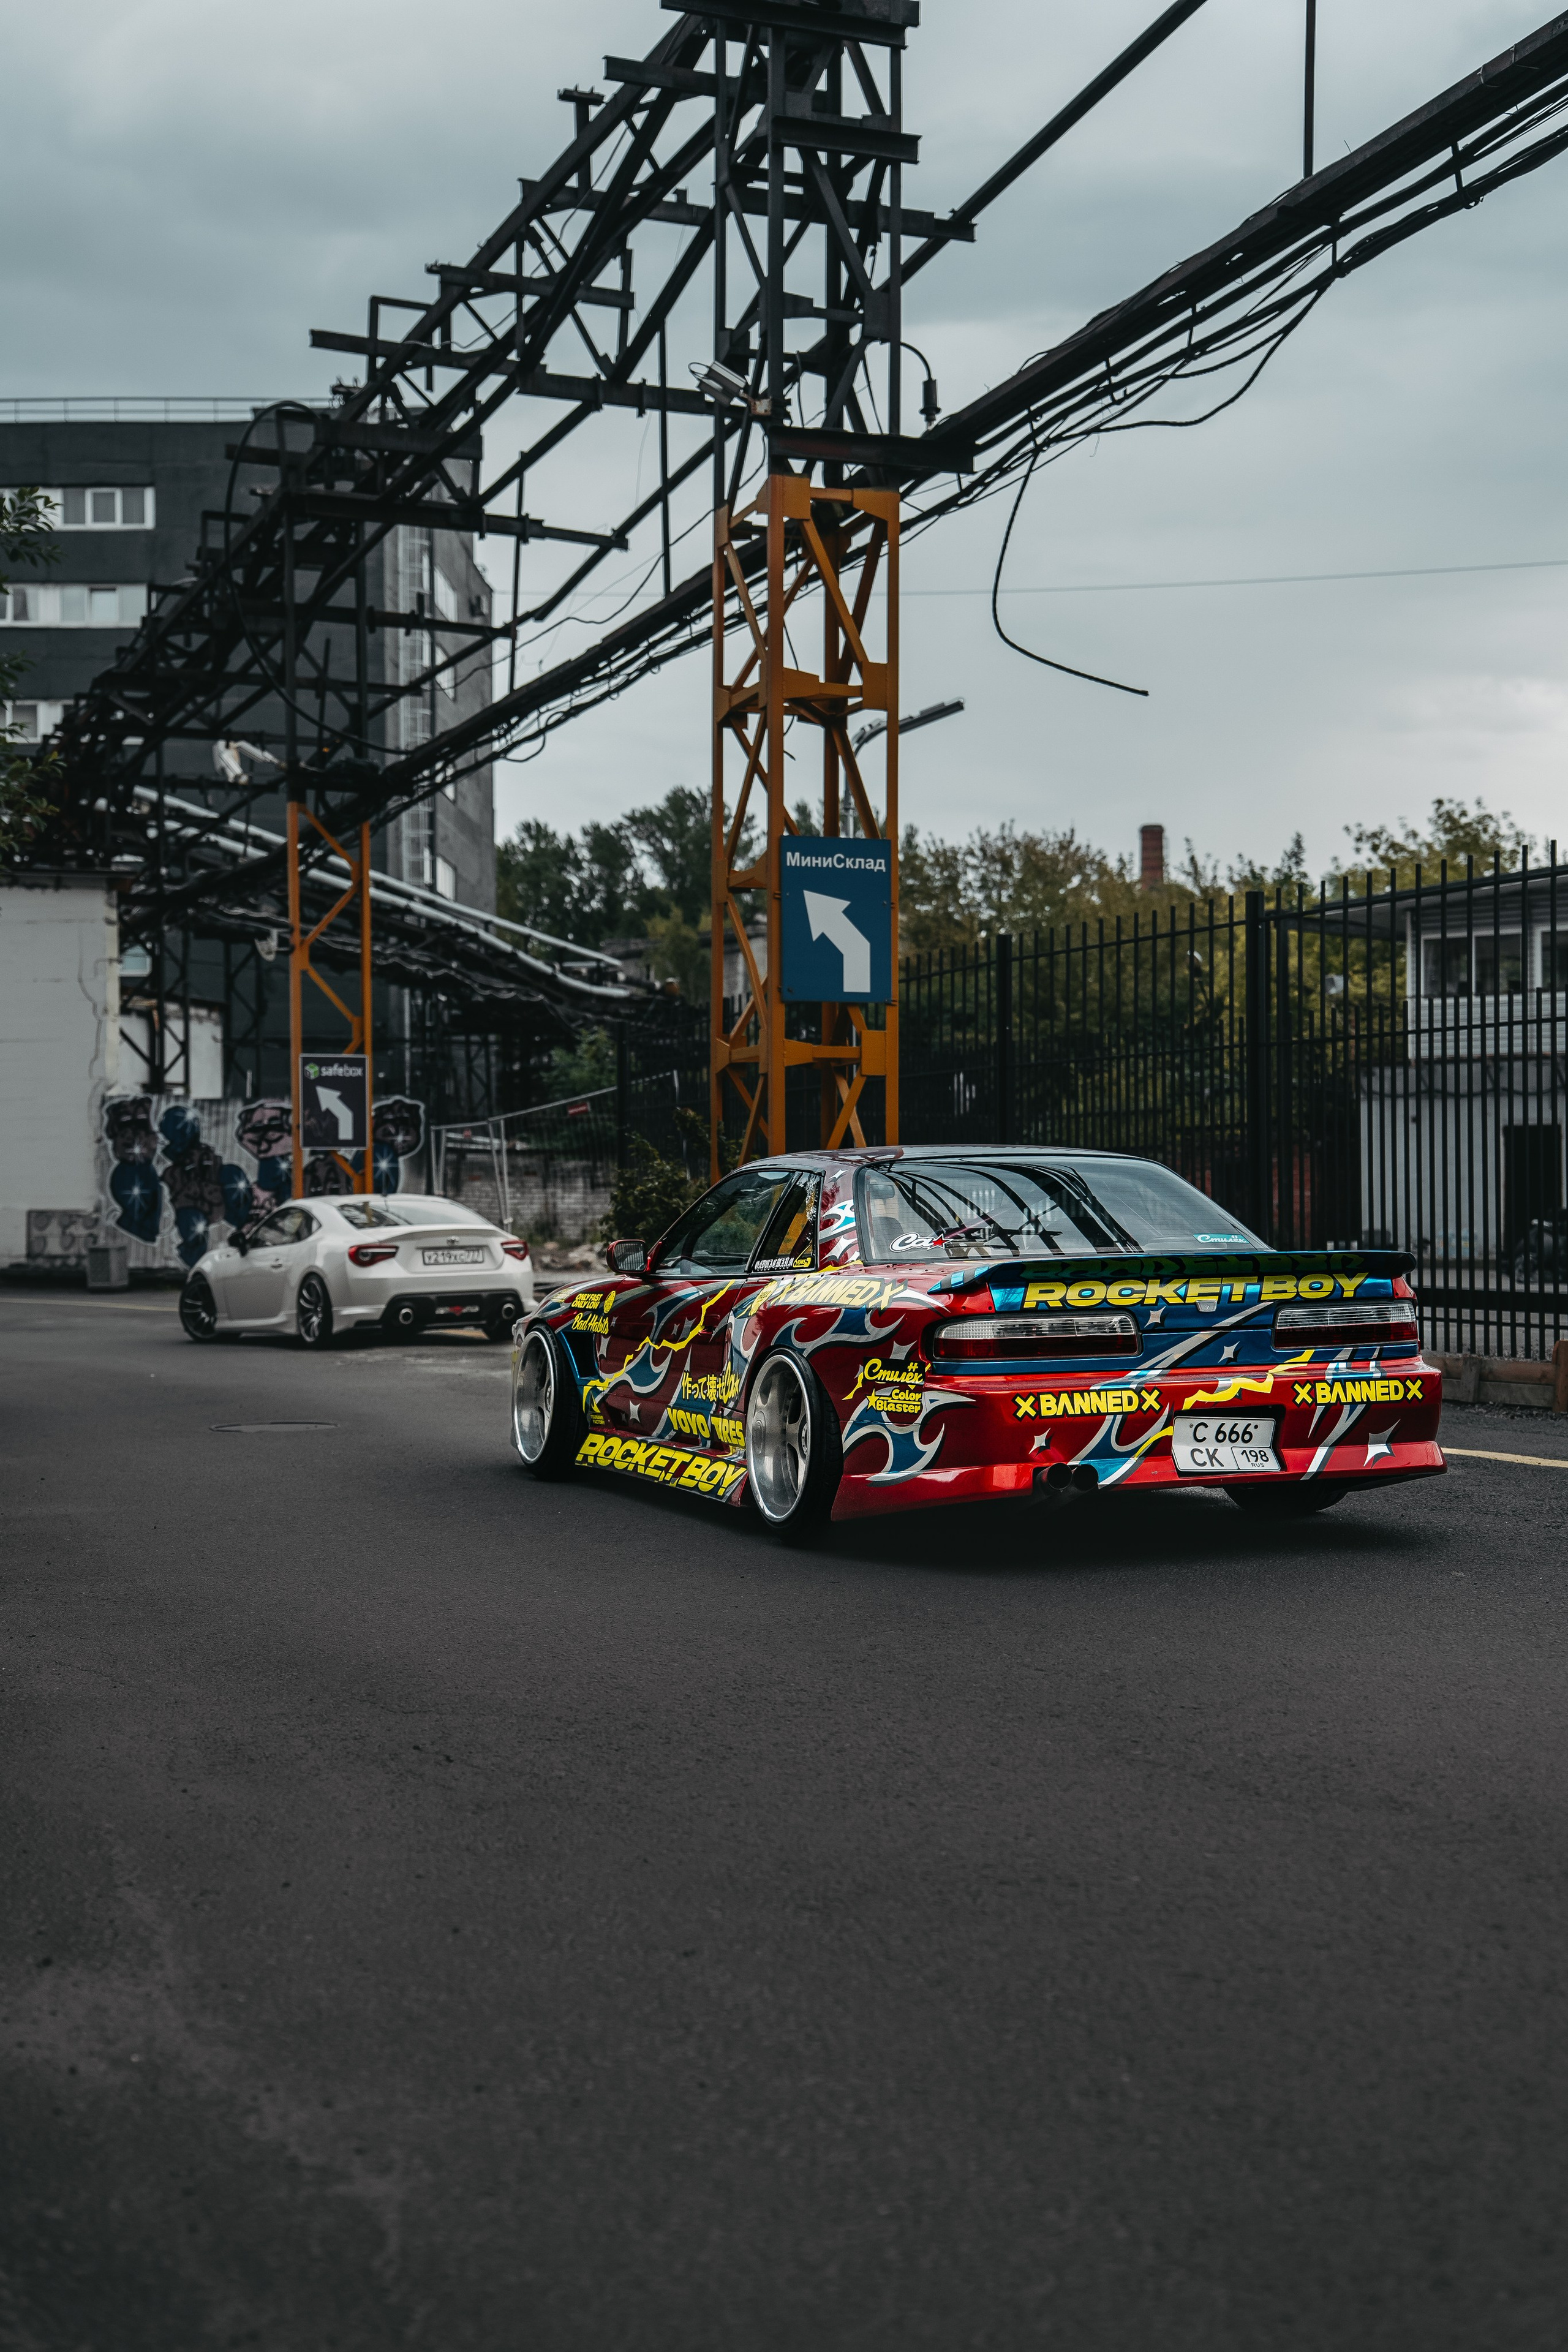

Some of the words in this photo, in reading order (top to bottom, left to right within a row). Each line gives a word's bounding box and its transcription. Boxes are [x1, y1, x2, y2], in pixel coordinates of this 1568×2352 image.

[786, 852, 886, 872] МиниСклад
[320, 1063, 363, 1077] safebox
[571, 1300, 589, 1309] ONLY
[586, 1301, 600, 1310] LOW
[571, 1313, 592, 1330] Bad
[587, 1313, 609, 1335] Habits
[891, 1389, 922, 1401] Color
[876, 1400, 921, 1414] Blaster
[666, 1408, 710, 1438] YOYO
[710, 1416, 745, 1447] TIRES
[1215, 1422, 1253, 1444] 666
[1240, 1450, 1269, 1463] 198
